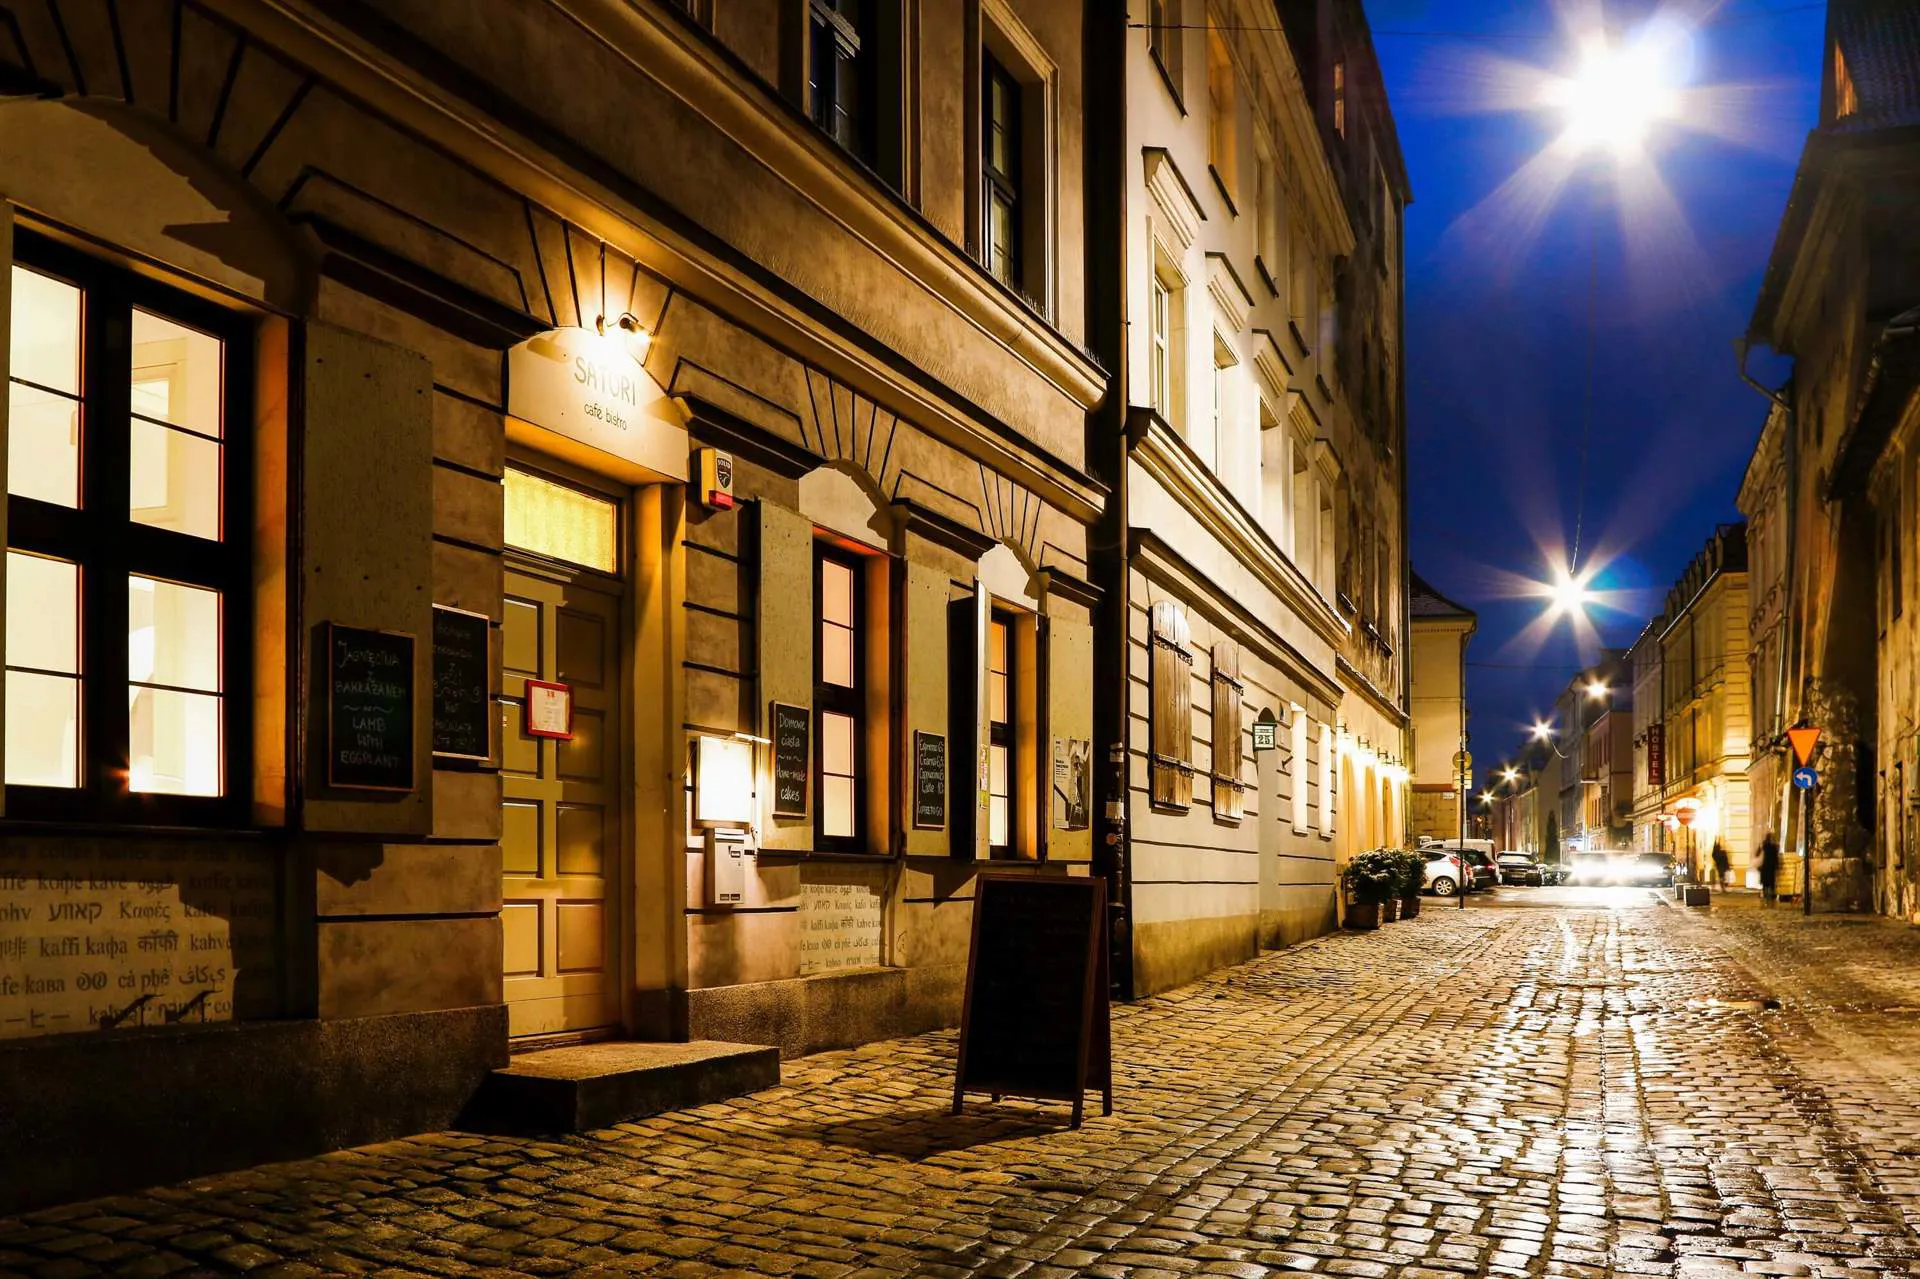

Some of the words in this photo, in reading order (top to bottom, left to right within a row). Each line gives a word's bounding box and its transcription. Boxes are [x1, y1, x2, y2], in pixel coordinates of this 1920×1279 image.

[606, 407, 628, 430] bistro
[352, 716, 387, 733] LAMB
[1258, 735, 1272, 745] 25
[339, 750, 401, 769] EGGPLANT
[1651, 726, 1661, 777] HOSTEL
[780, 785, 801, 802] cakes
[40, 936, 80, 957] kaffi
